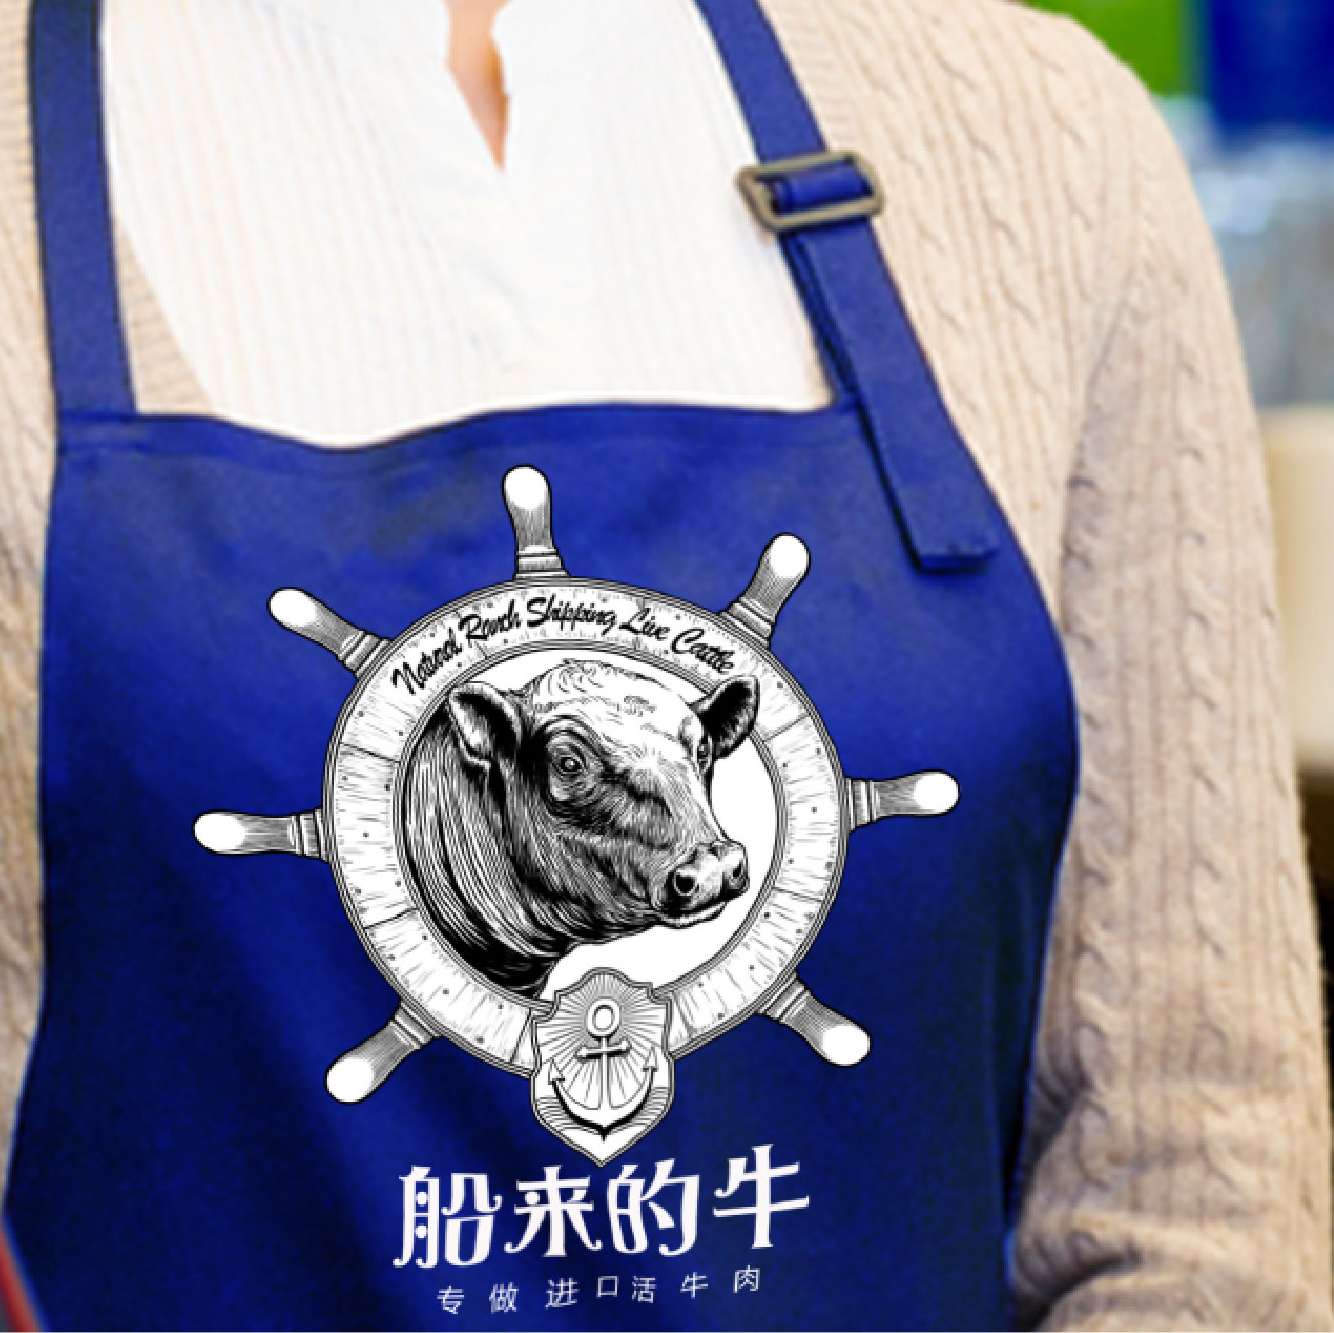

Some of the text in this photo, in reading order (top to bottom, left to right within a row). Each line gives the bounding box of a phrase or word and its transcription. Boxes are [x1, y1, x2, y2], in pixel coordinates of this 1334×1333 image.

[460, 598, 521, 643] Ranch
[527, 594, 617, 635] Shipping
[618, 606, 672, 641] Live
[392, 1144, 810, 1268] 船来的牛
[436, 1266, 762, 1315] 专做进口活牛肉
